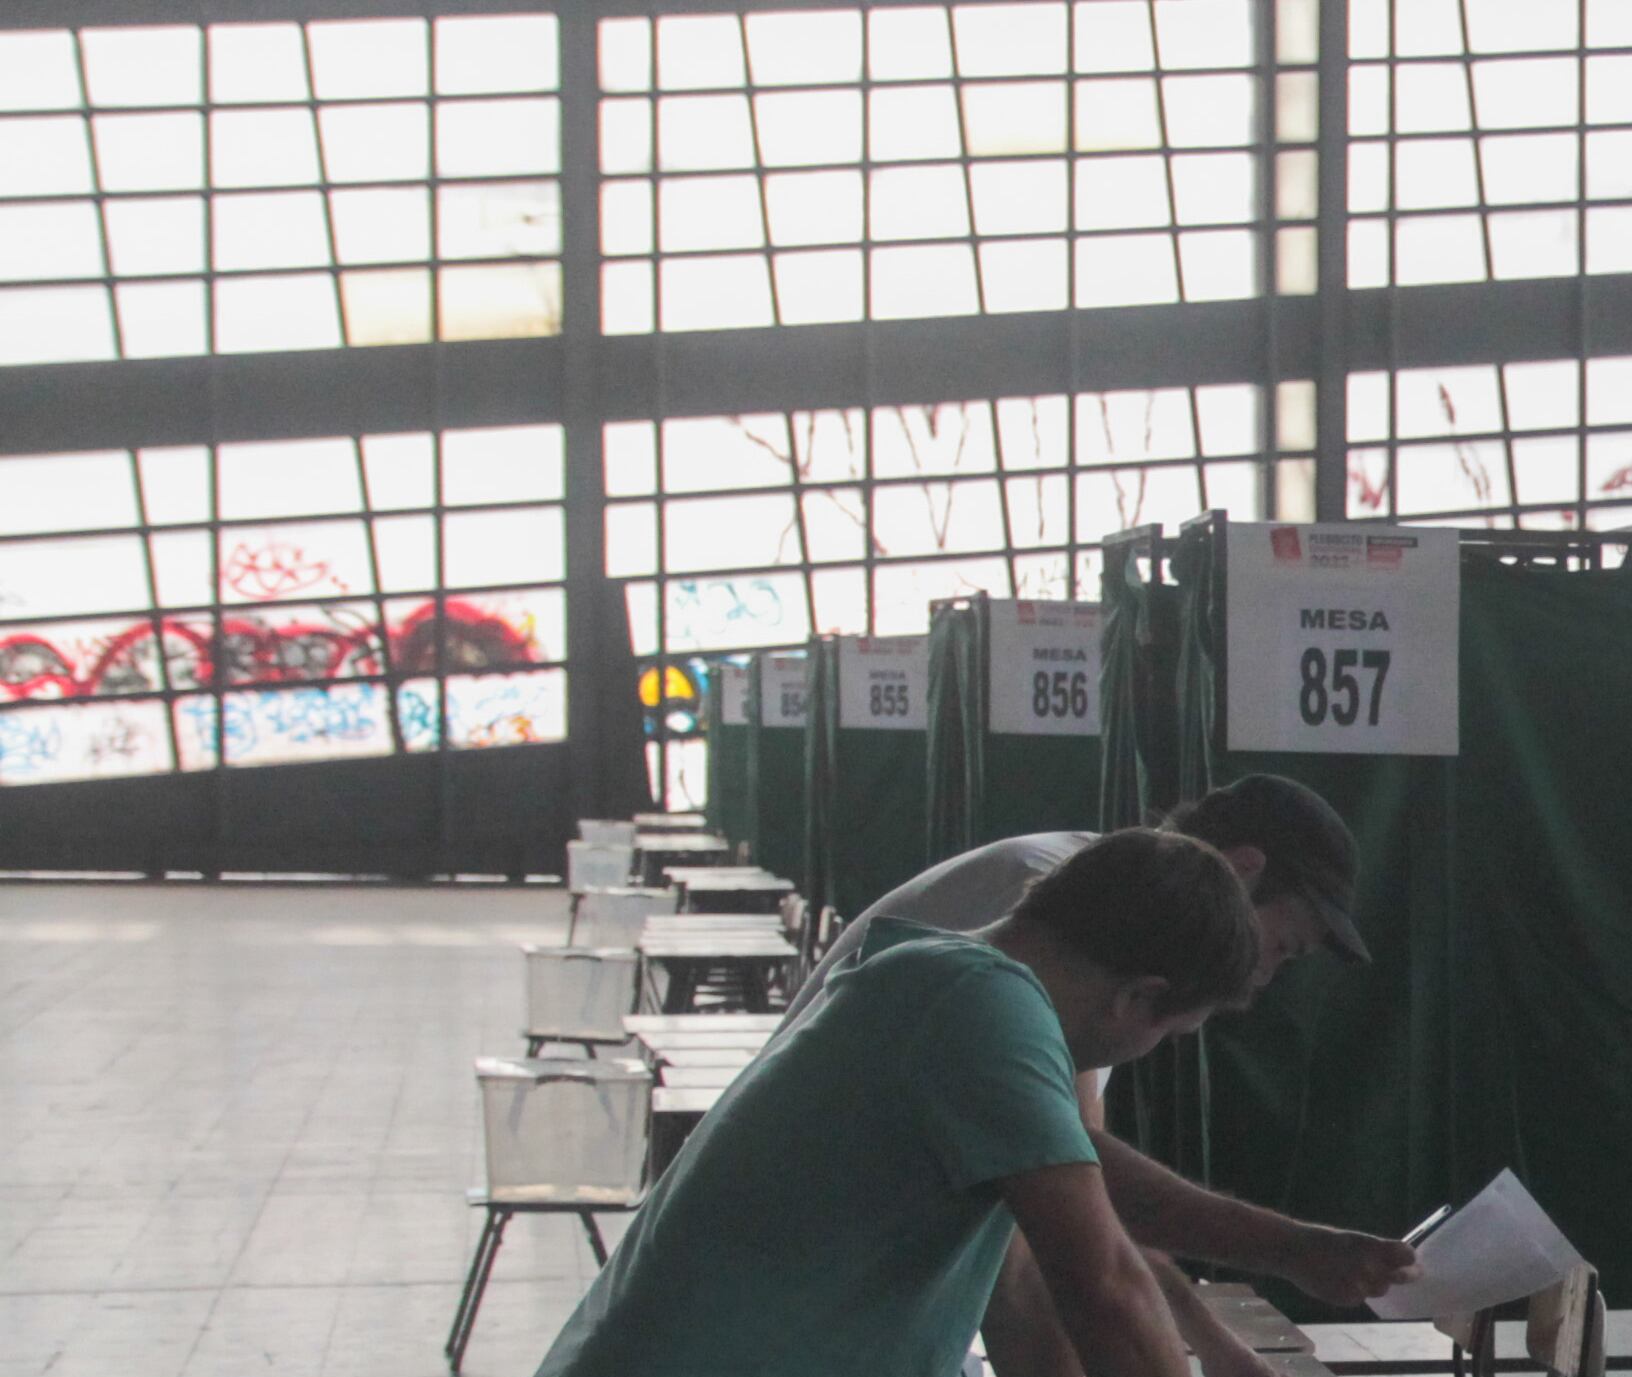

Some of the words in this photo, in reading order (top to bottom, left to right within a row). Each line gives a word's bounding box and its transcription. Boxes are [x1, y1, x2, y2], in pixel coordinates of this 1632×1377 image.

[1300, 608, 1390, 631] MESA
[1033, 648, 1087, 661] MESA
[870, 684, 909, 717] 855
[1032, 671, 1088, 718] 856
[1299, 647, 1391, 726] 857
